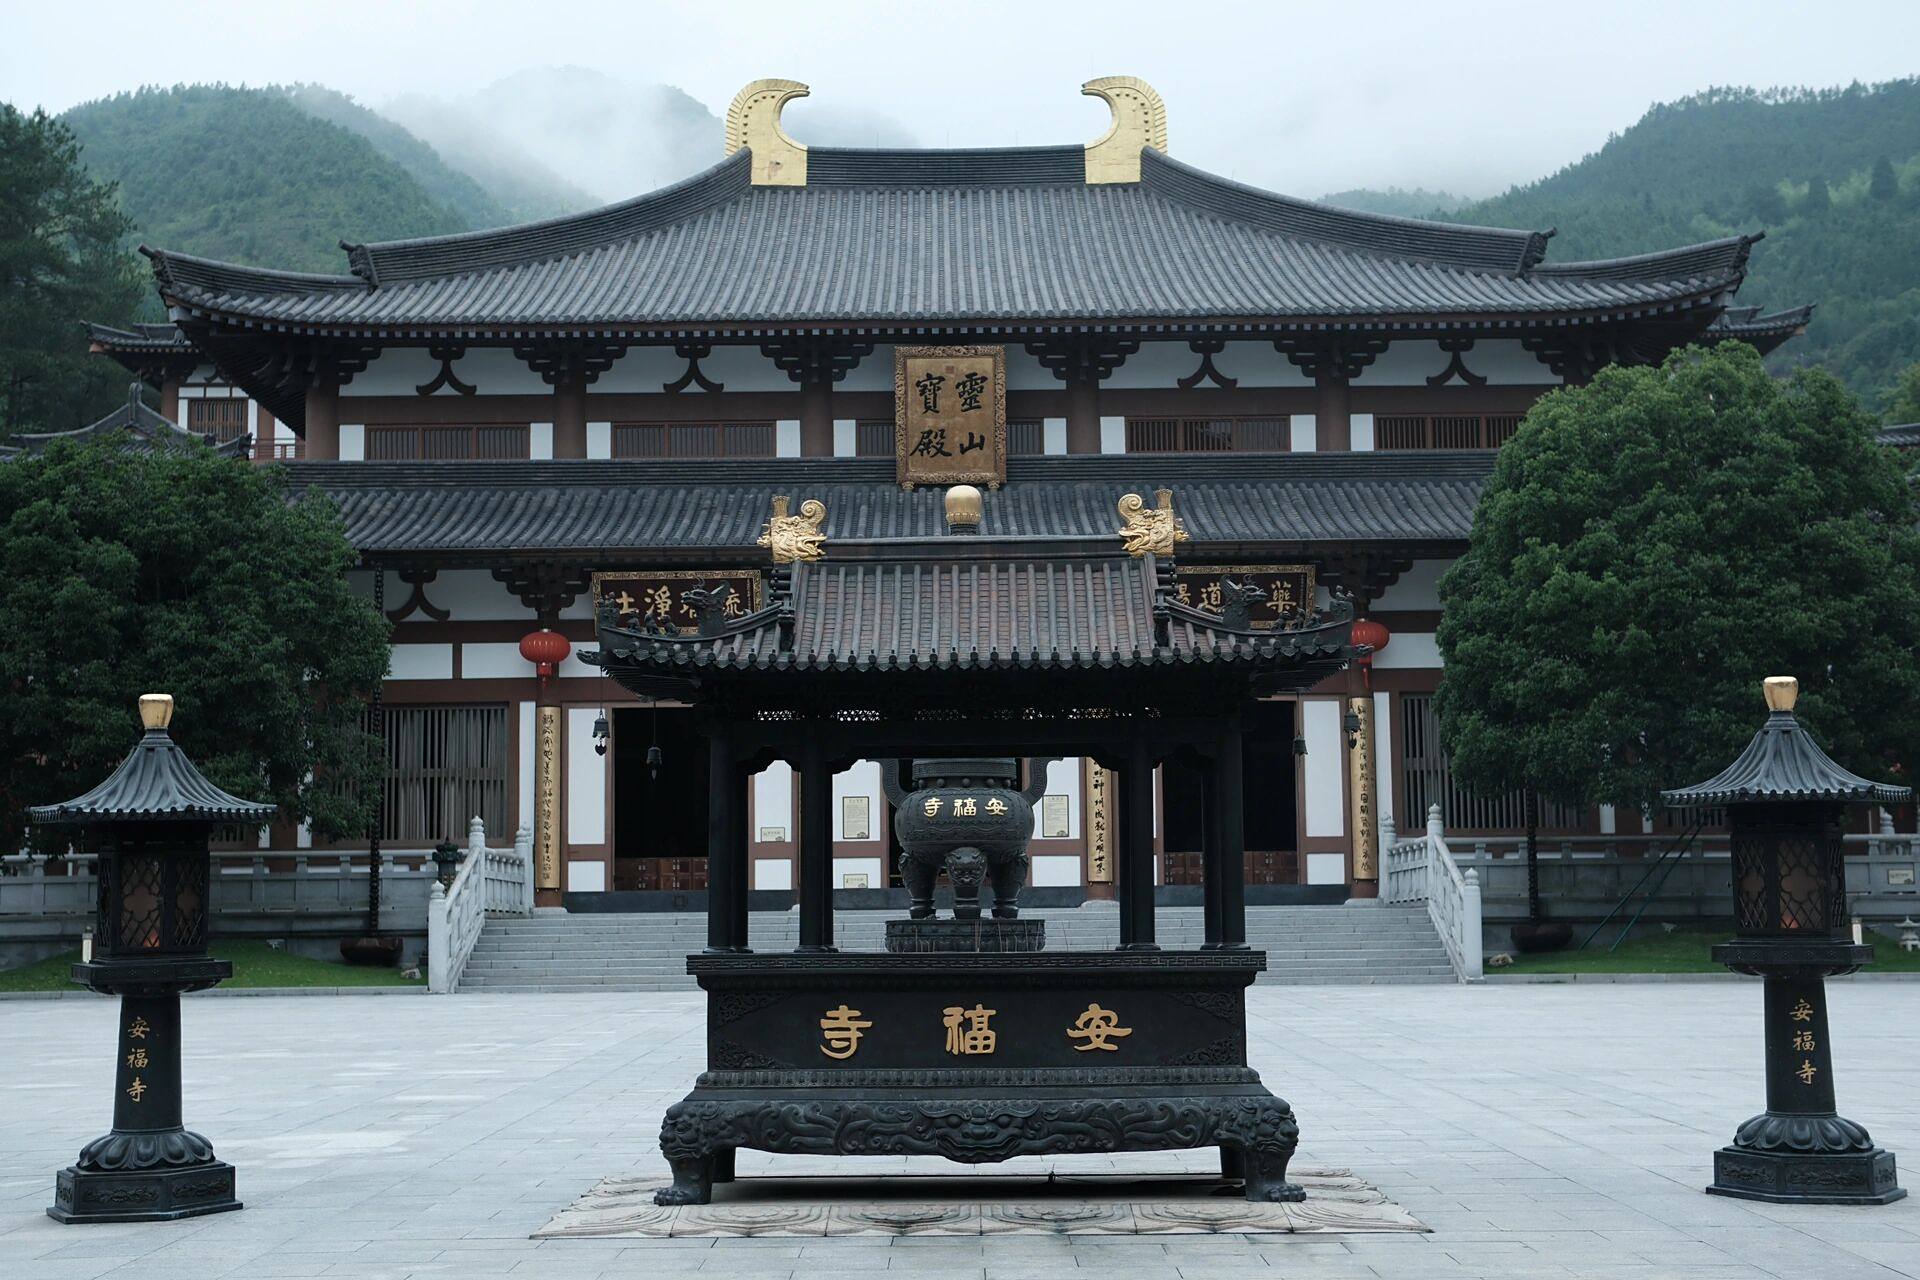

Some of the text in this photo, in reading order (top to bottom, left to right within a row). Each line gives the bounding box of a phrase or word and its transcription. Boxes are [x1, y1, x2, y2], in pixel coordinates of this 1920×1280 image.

[909, 372, 953, 458] 寶殿
[955, 371, 989, 455] 靈山
[923, 797, 1009, 818] 安福寺
[126, 1015, 151, 1103] 安福寺
[819, 1003, 1133, 1060] 安福寺
[1788, 998, 1818, 1086] 安福寺
